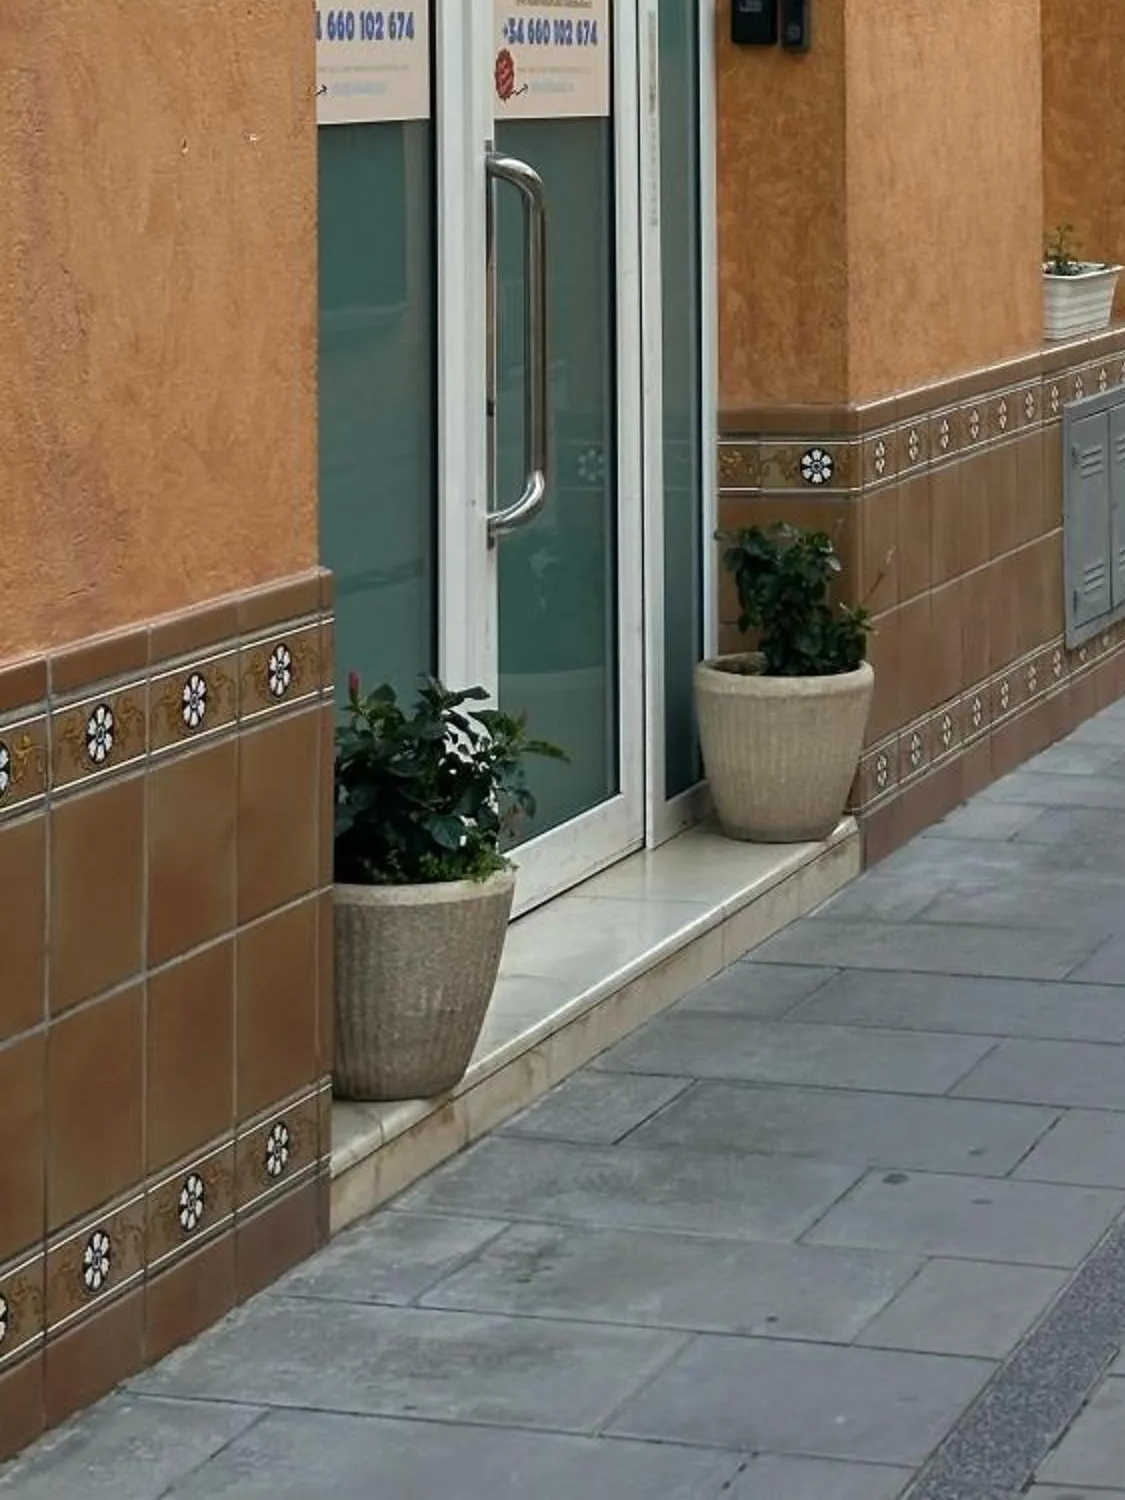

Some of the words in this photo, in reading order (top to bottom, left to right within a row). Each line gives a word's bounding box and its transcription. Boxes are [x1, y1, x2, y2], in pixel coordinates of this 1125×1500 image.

[327, 10, 355, 41] 660
[359, 11, 385, 41] 102
[388, 11, 415, 41] 674
[527, 18, 551, 45] 660
[553, 19, 573, 45] 102
[576, 19, 598, 46] 674
